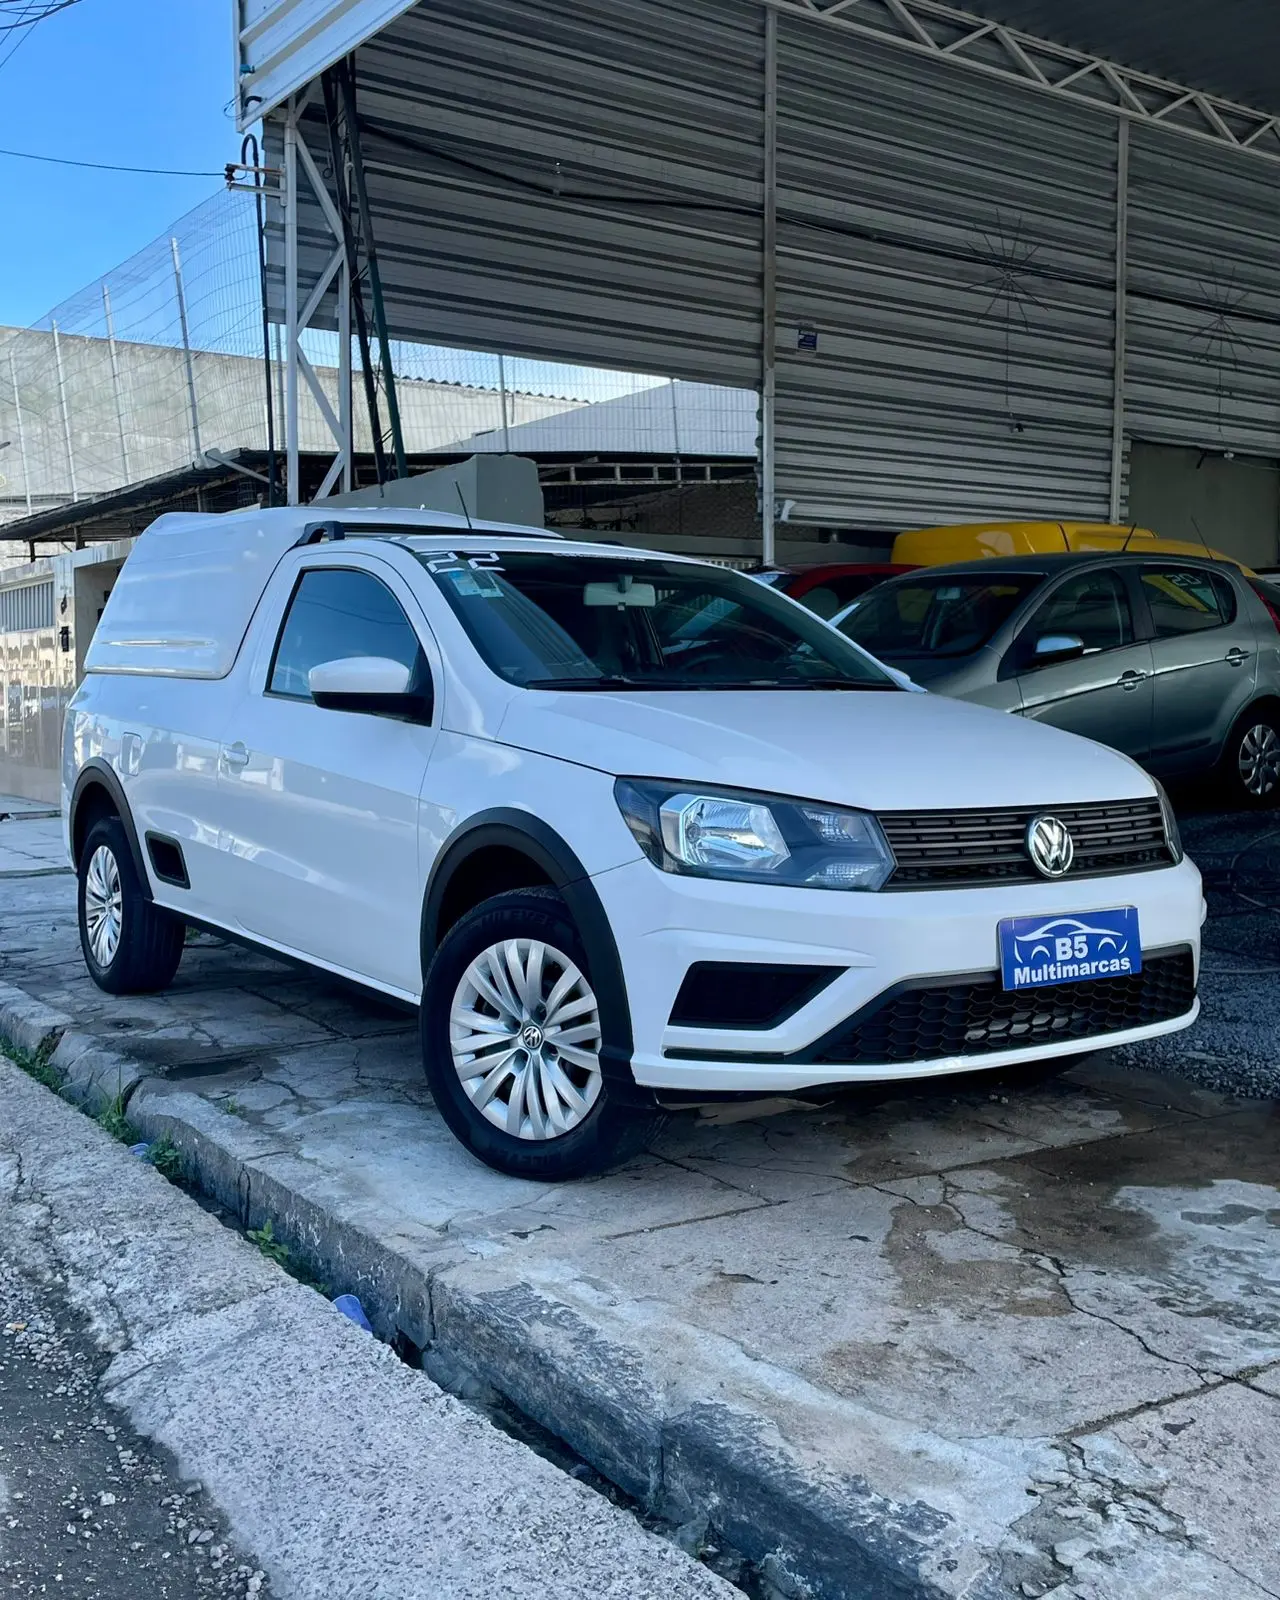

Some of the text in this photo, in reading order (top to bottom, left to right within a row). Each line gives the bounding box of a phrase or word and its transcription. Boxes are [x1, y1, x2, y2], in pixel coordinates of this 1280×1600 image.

[421, 552, 506, 573] 22
[1029, 817, 1073, 877] VW
[1055, 935, 1089, 961] B5
[1013, 957, 1131, 984] Multimarcas
